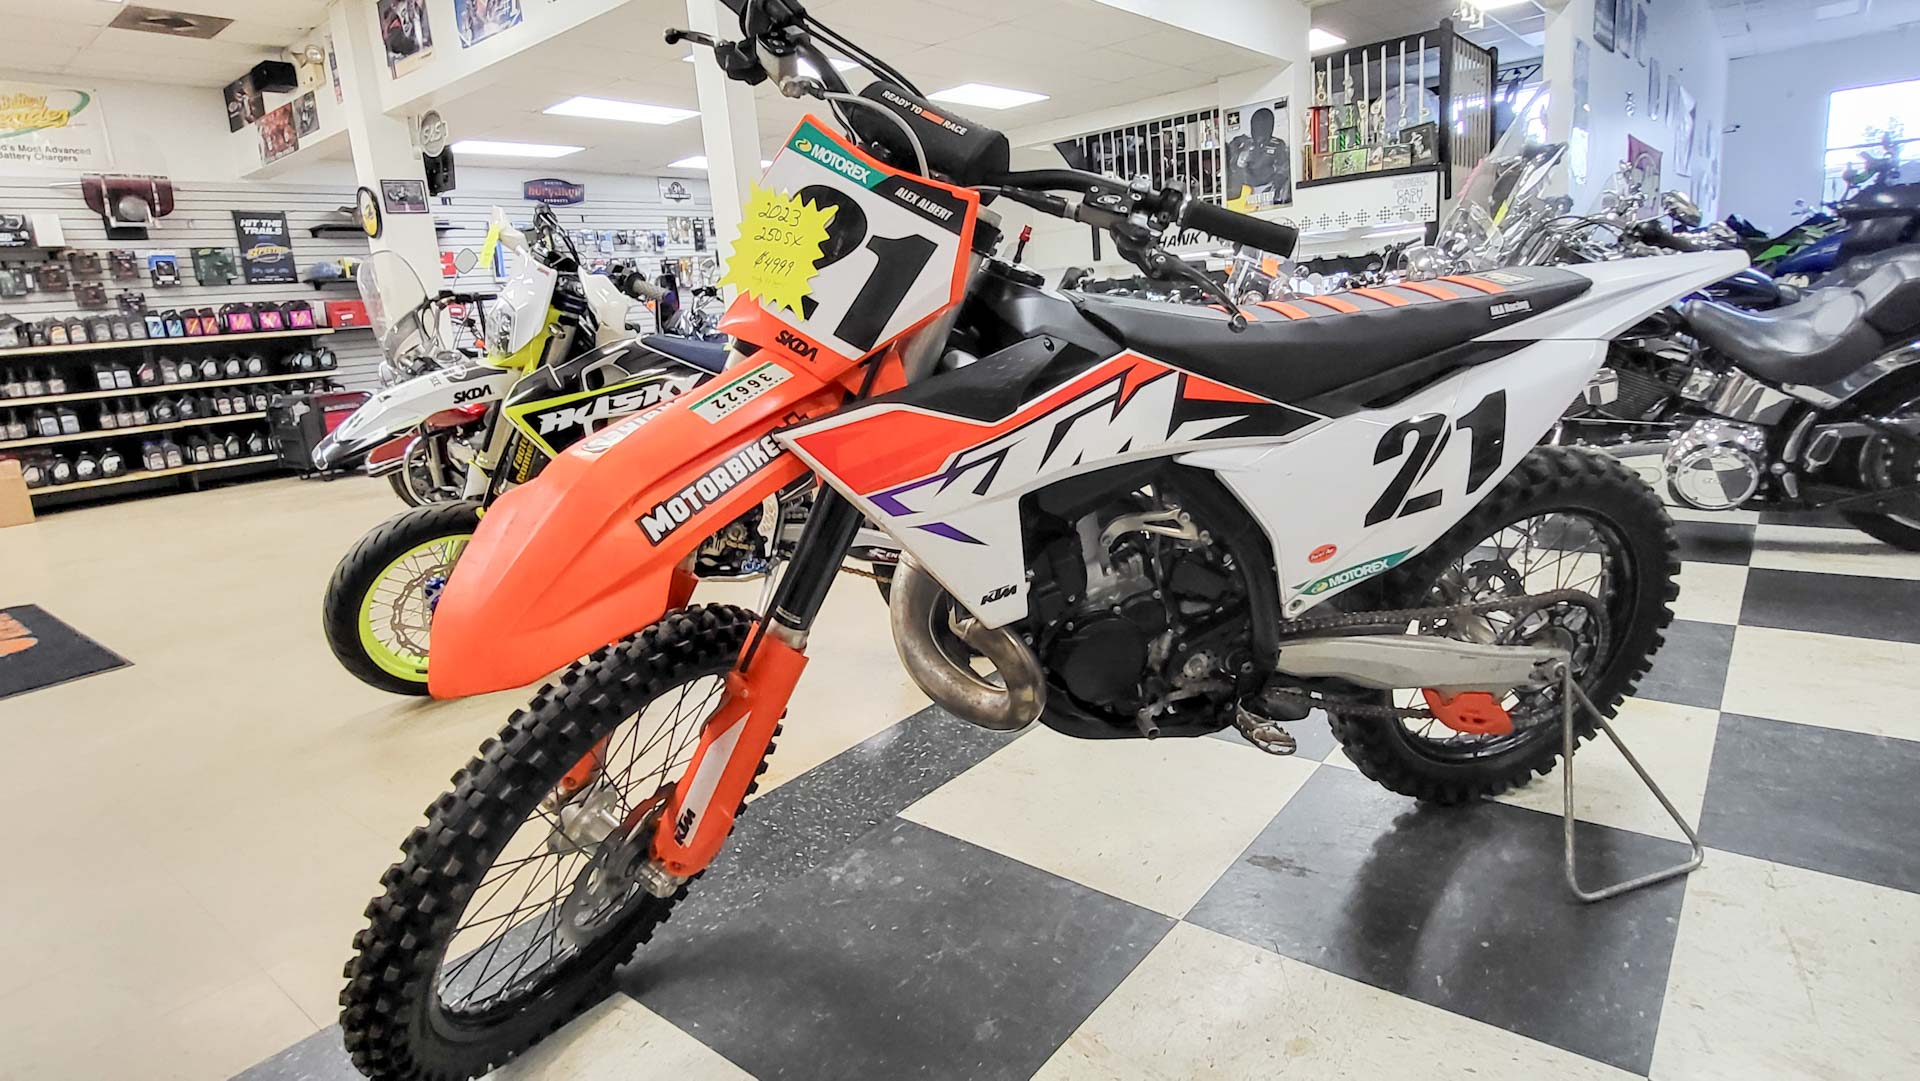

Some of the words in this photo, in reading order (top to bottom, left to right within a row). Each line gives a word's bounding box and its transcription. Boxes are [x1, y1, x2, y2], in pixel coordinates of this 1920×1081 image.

[881, 90, 911, 108] READY
[910, 103, 922, 114] TO
[942, 120, 968, 136] RACE
[34, 153, 78, 163] Chargers
[45, 146, 91, 155] Advanced
[810, 143, 871, 184] MOTOREX
[758, 202, 802, 227] 2023
[894, 187, 918, 205] ALEX
[916, 197, 954, 221] ALBERT
[240, 219, 260, 227] HIT
[260, 219, 283, 228] THE
[243, 227, 283, 235] TRAILS
[1158, 231, 1201, 248] HANK
[775, 329, 819, 362] SKDA
[453, 384, 492, 404] SKDA
[711, 373, 772, 409] 36622
[1363, 388, 1507, 528] 21
[1328, 559, 1389, 588] MOTOREX
[980, 584, 1017, 605] KTM
[675, 808, 696, 846] KTM
